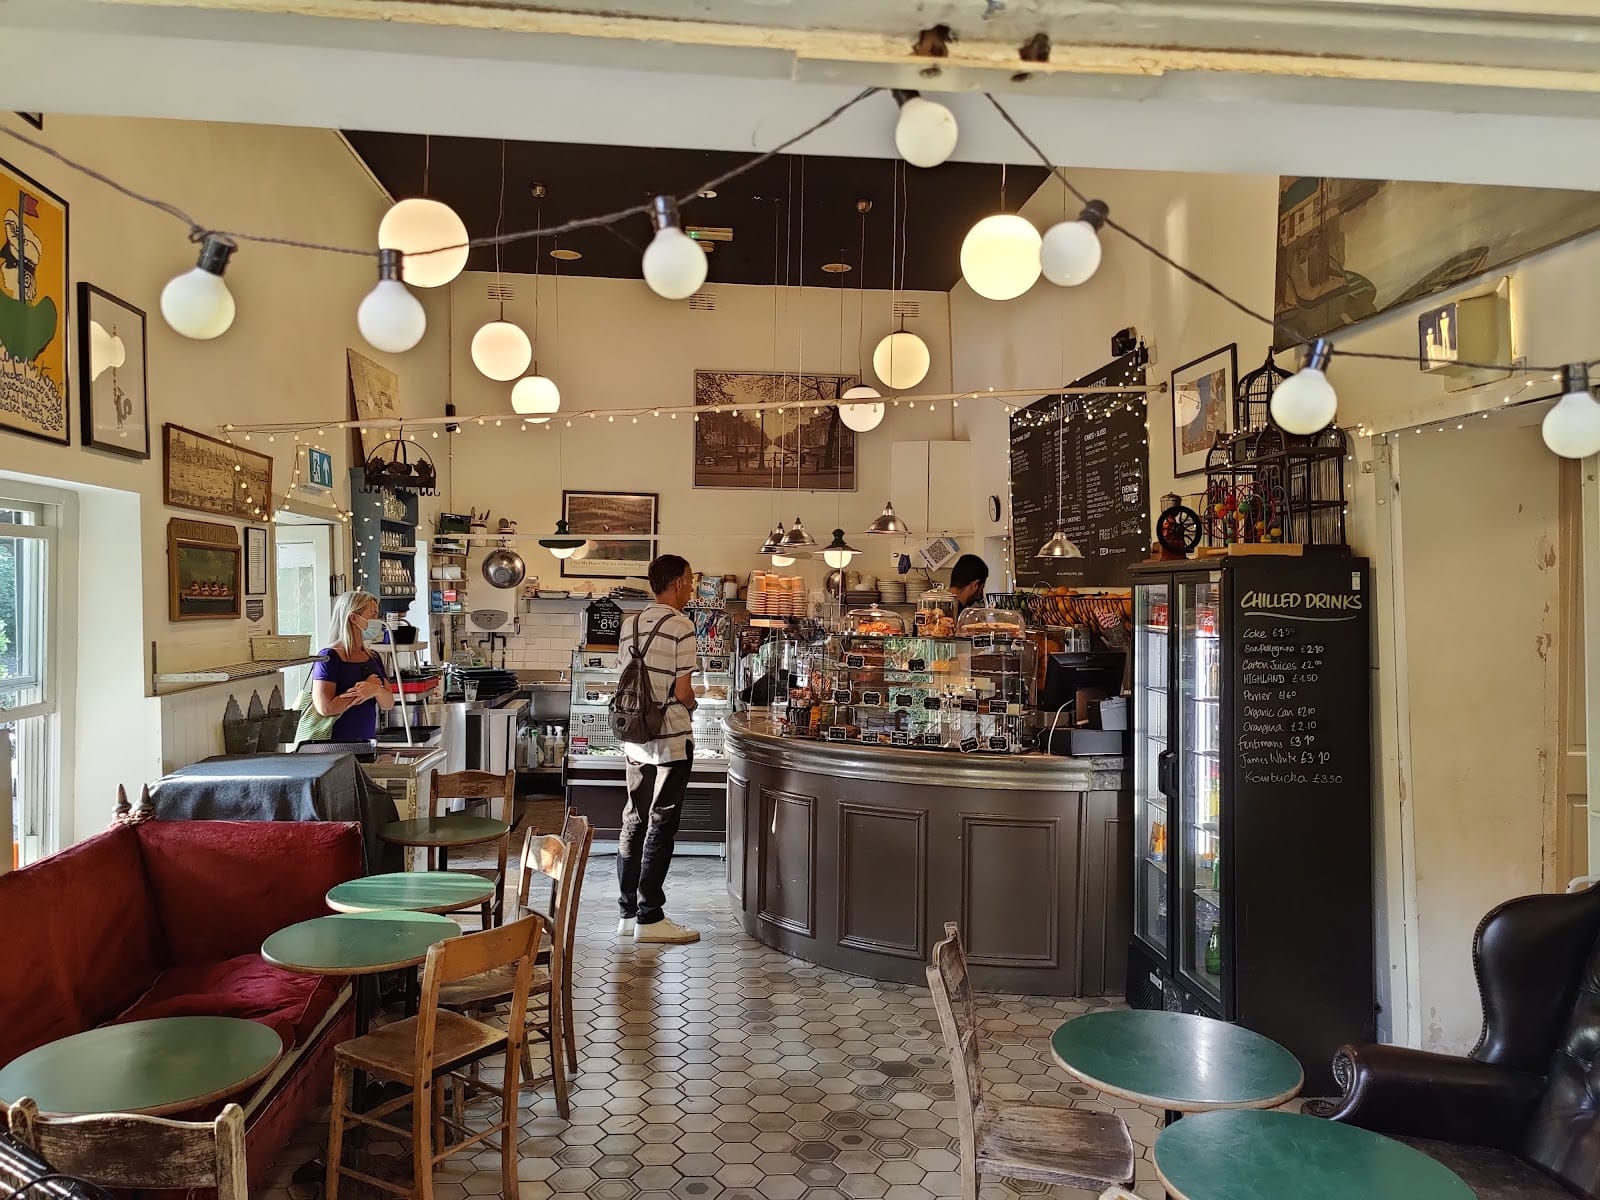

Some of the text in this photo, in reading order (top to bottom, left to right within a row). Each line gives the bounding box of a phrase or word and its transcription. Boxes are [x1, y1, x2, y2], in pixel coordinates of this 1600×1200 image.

[1241, 590, 1363, 610] CHILLED DRINKS
[1243, 628, 1267, 639] Coke
[1270, 660, 1297, 671] Juices
[1243, 673, 1285, 685] HIGHLAND
[1243, 706, 1275, 719] Organic
[1238, 733, 1283, 751] Fentimans
[1240, 752, 1269, 768] James
